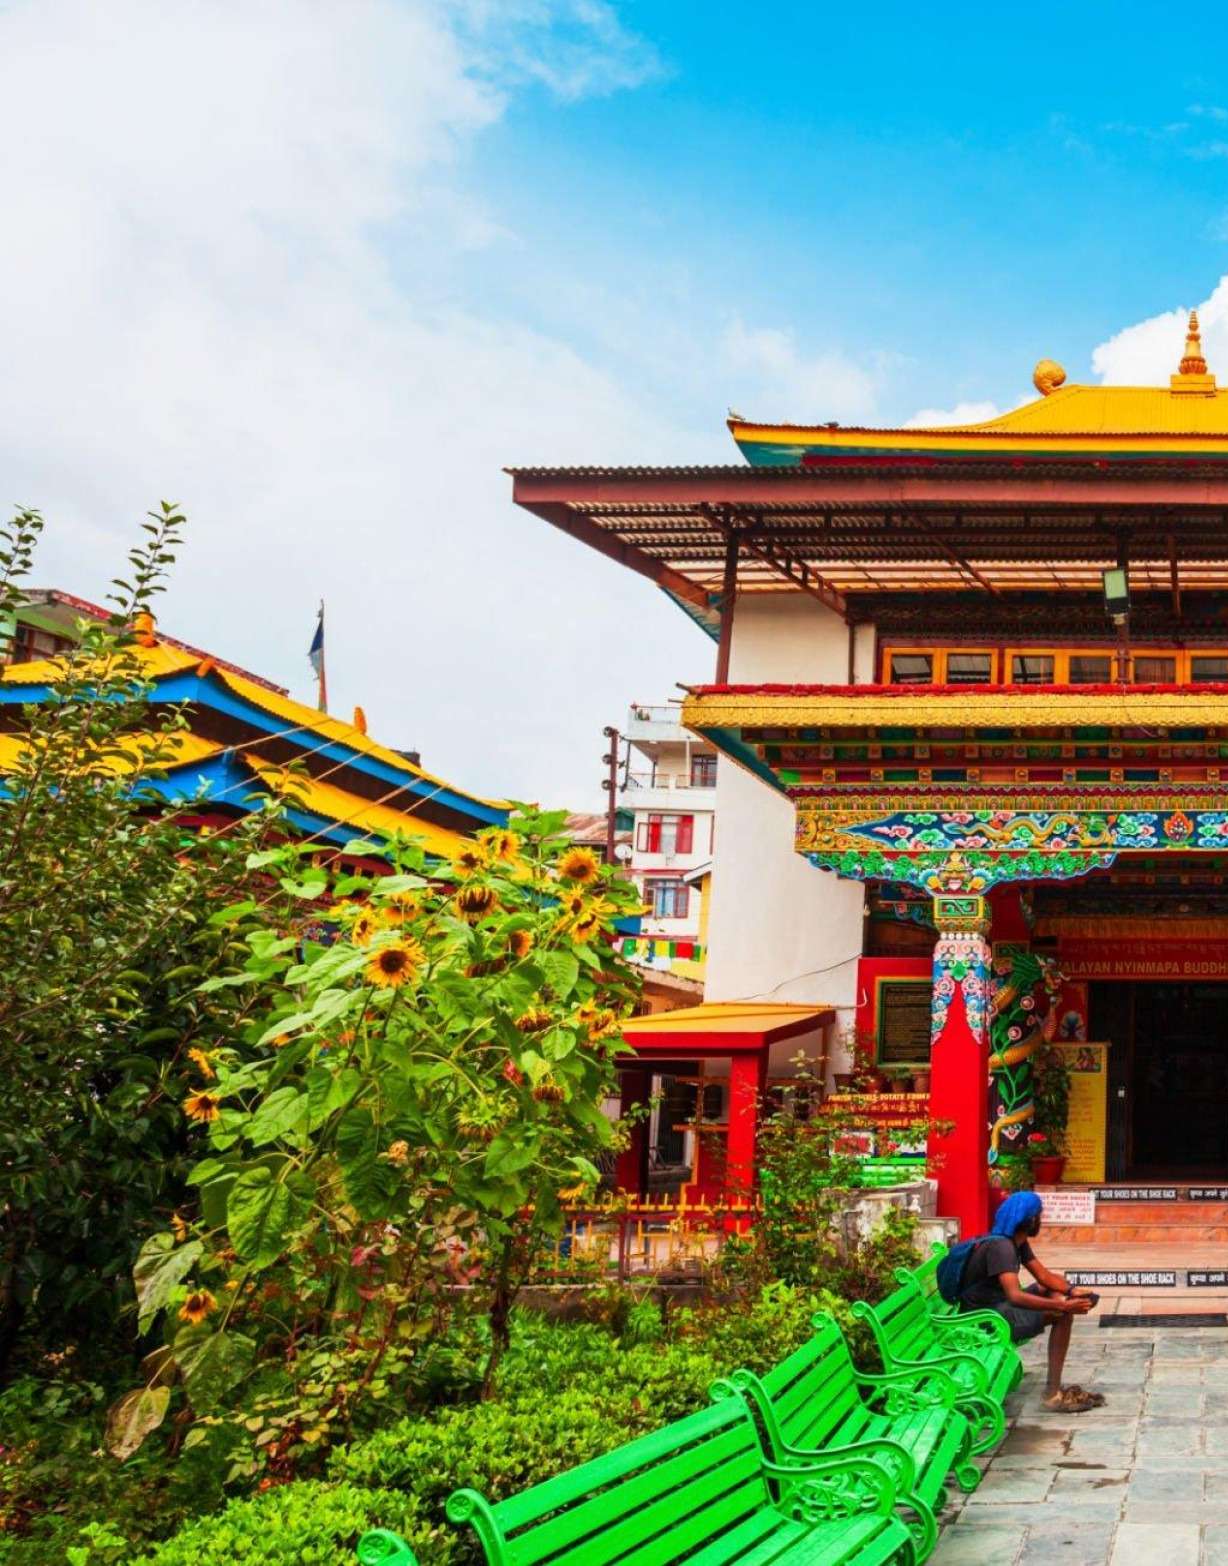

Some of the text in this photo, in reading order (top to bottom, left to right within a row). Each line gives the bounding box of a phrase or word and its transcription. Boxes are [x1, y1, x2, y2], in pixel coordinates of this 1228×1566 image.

[1058, 960, 1111, 974] ALAYAN
[1114, 1189, 1130, 1199] SHOES
[1139, 1189, 1148, 1199] THE
[1079, 1273, 1095, 1284] YOUR
[1097, 1273, 1117, 1284] SHOES
[1117, 1273, 1126, 1284] ON
[1128, 1273, 1140, 1284] THE
[1140, 1273, 1158, 1284] SHOE
[1158, 1273, 1174, 1284] RACK
